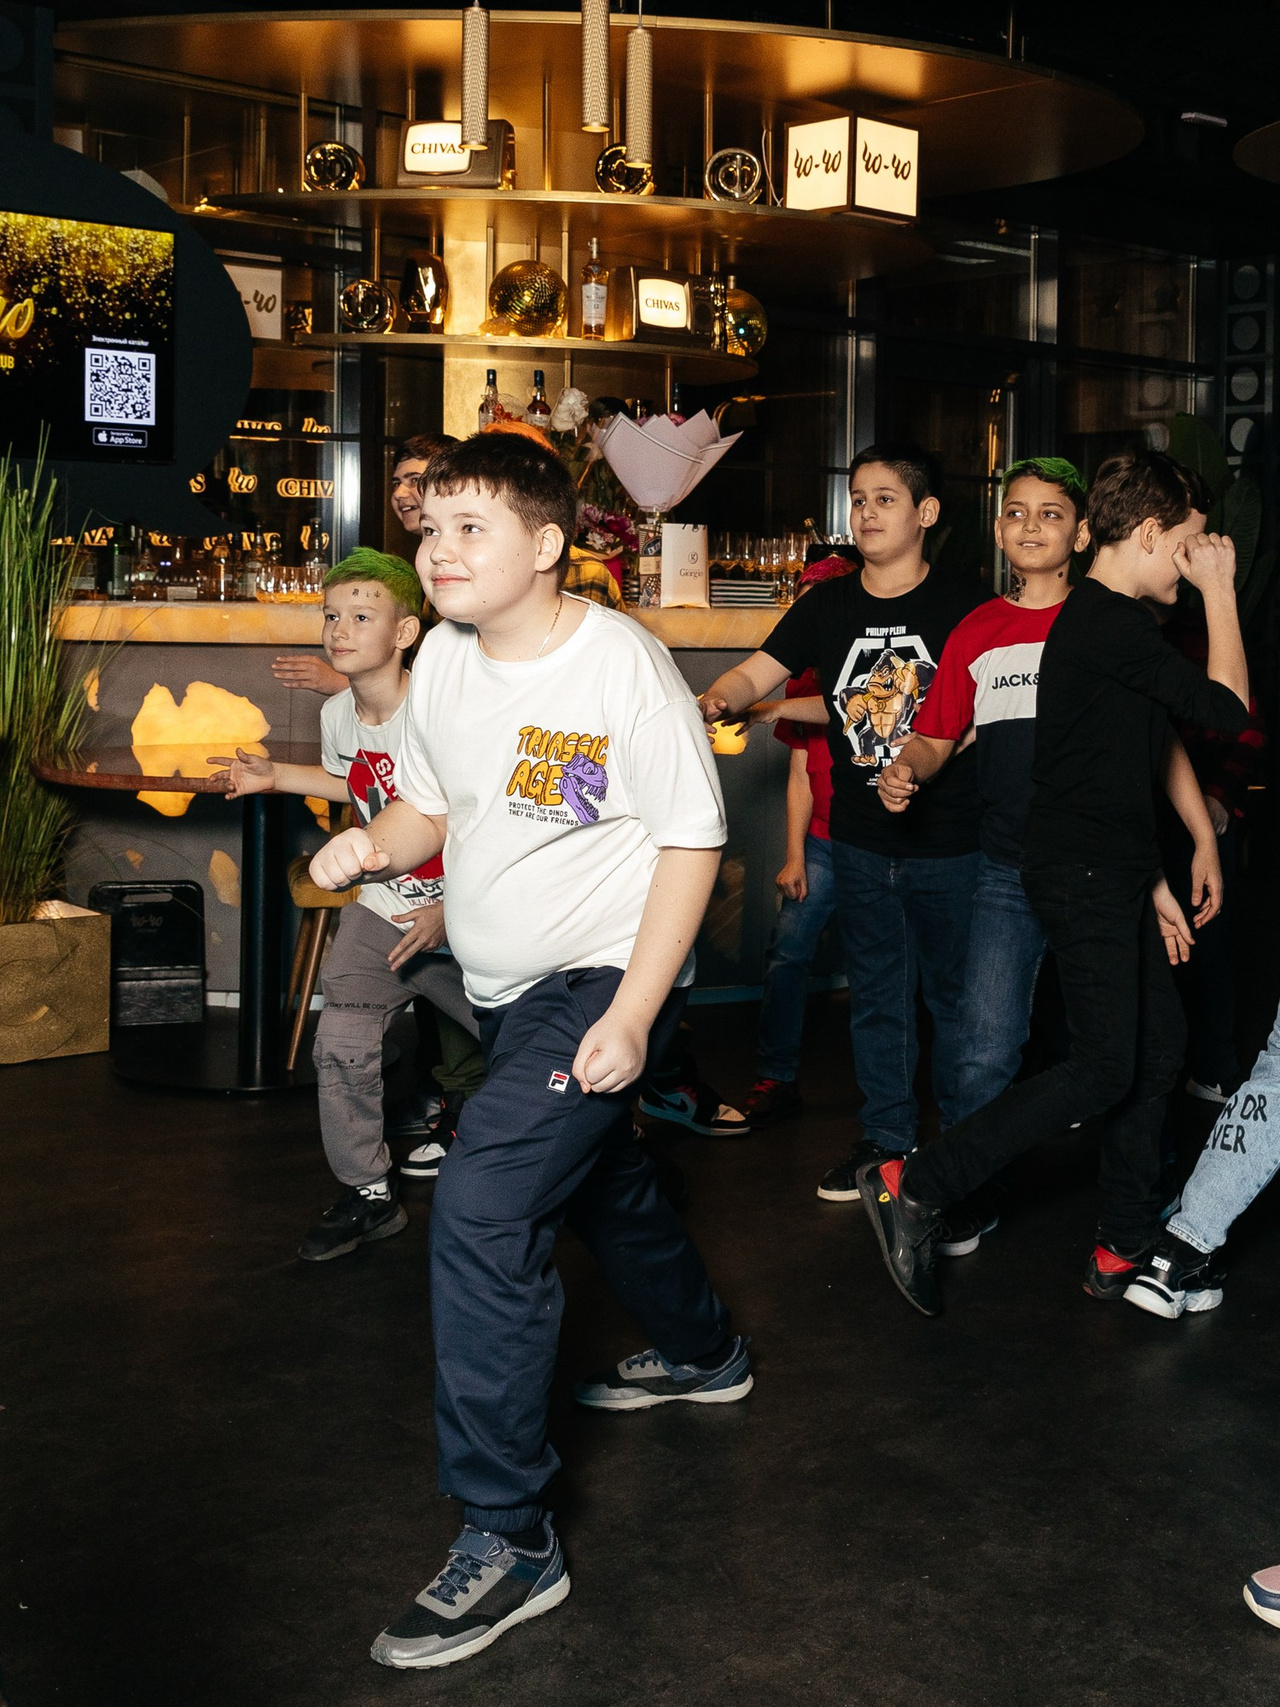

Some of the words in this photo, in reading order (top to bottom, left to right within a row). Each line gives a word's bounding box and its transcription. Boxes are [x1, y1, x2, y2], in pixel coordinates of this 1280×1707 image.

[793, 148, 842, 179] 40-40
[862, 139, 911, 181] 40-40
[645, 297, 681, 312] CHIVAS
[109, 435, 125, 445] App
[125, 436, 143, 446] Store
[679, 568, 704, 580] Giorgio
[517, 725, 609, 767] TRIASSIC
[506, 759, 566, 806] AGE
[508, 801, 536, 812] PROTECT
[536, 806, 547, 815] THE
[548, 809, 569, 818] DINOS
[508, 808, 524, 818] THEY
[524, 812, 536, 821] ARE
[536, 815, 549, 823] OUR
[550, 816, 579, 827] FRIENDS
[1240, 1093, 1267, 1122] OR
[1204, 1124, 1246, 1154] VER
